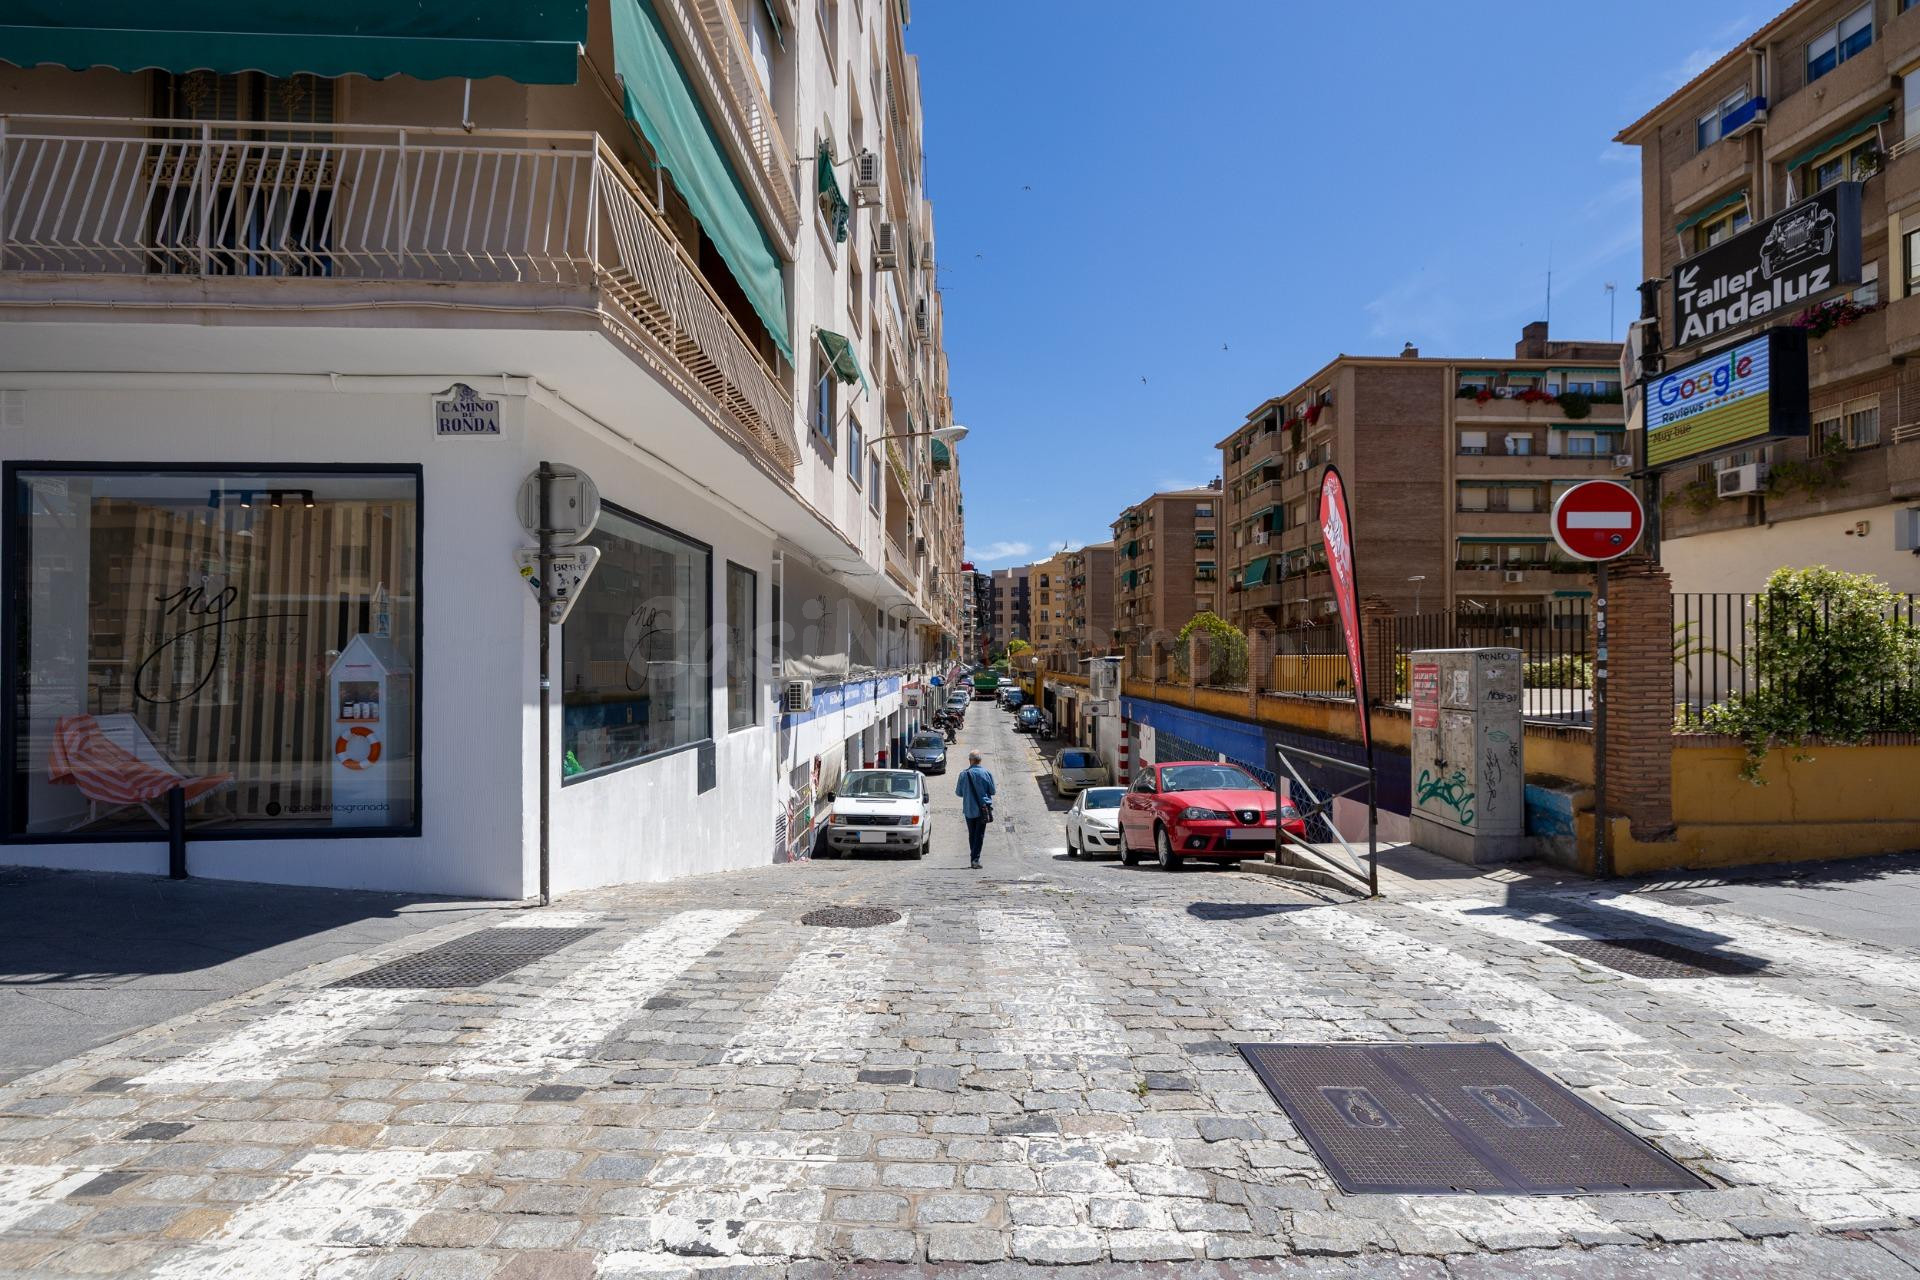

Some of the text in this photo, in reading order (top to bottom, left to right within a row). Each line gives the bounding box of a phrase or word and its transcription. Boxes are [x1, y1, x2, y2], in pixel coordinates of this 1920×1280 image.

[1679, 265, 1760, 315] Taller
[1679, 264, 1831, 346] Andaluz
[1658, 351, 1753, 406] Google
[440, 418, 497, 432] RONDA
[441, 402, 494, 412] CAMINO
[1662, 402, 1704, 424] Reviews
